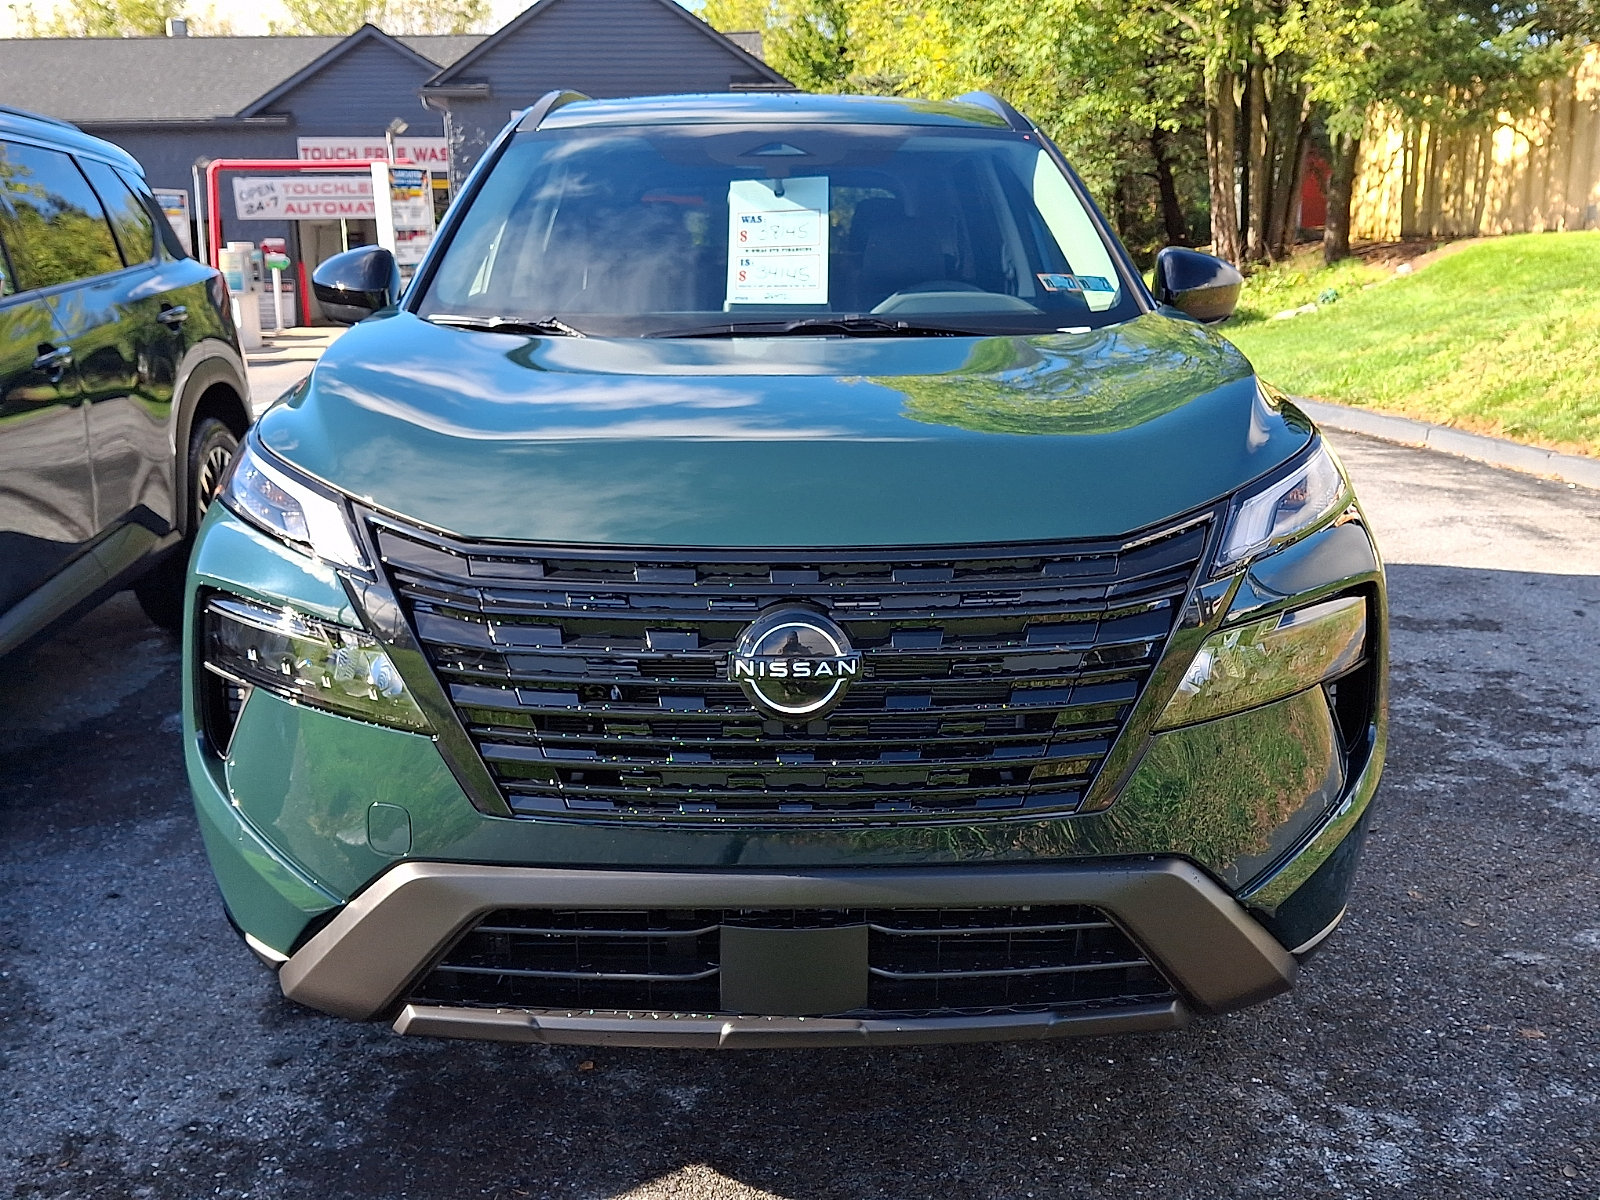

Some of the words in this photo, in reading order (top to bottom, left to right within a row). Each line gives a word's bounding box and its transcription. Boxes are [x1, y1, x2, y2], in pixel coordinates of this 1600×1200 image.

[301, 147, 357, 160] TOUCH
[364, 147, 406, 159] FRE
[240, 182, 276, 201] OPEN
[734, 659, 856, 678] NISSAN
